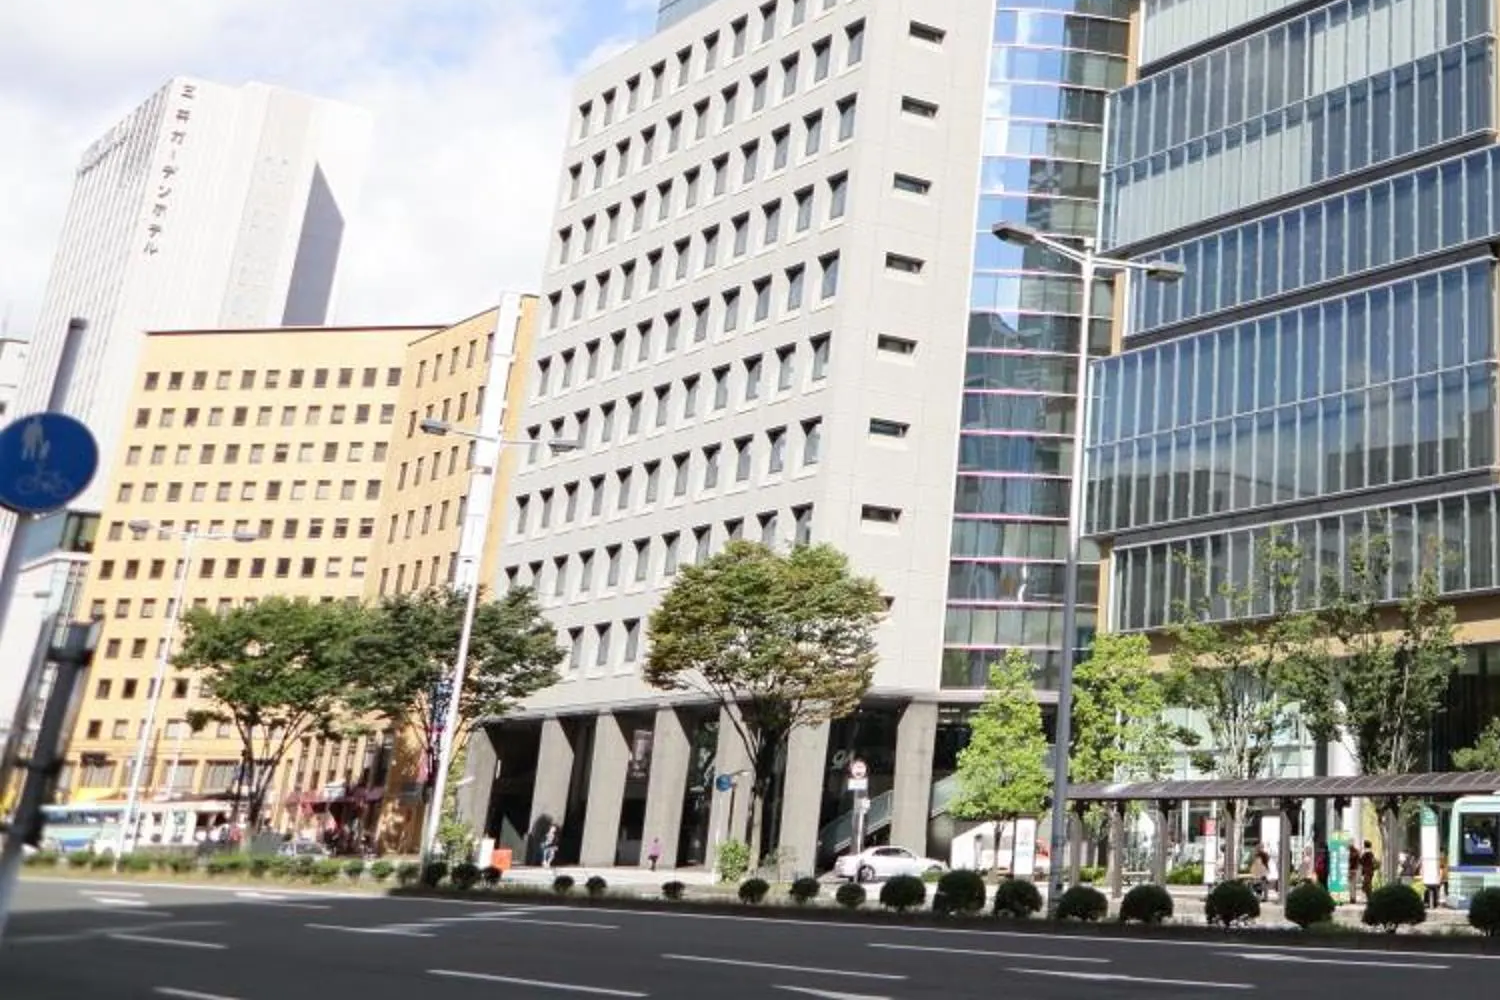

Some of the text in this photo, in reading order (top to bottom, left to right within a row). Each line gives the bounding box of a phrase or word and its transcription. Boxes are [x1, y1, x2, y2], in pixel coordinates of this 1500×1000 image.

[143, 84, 196, 256] 三井ガーデンホテル
